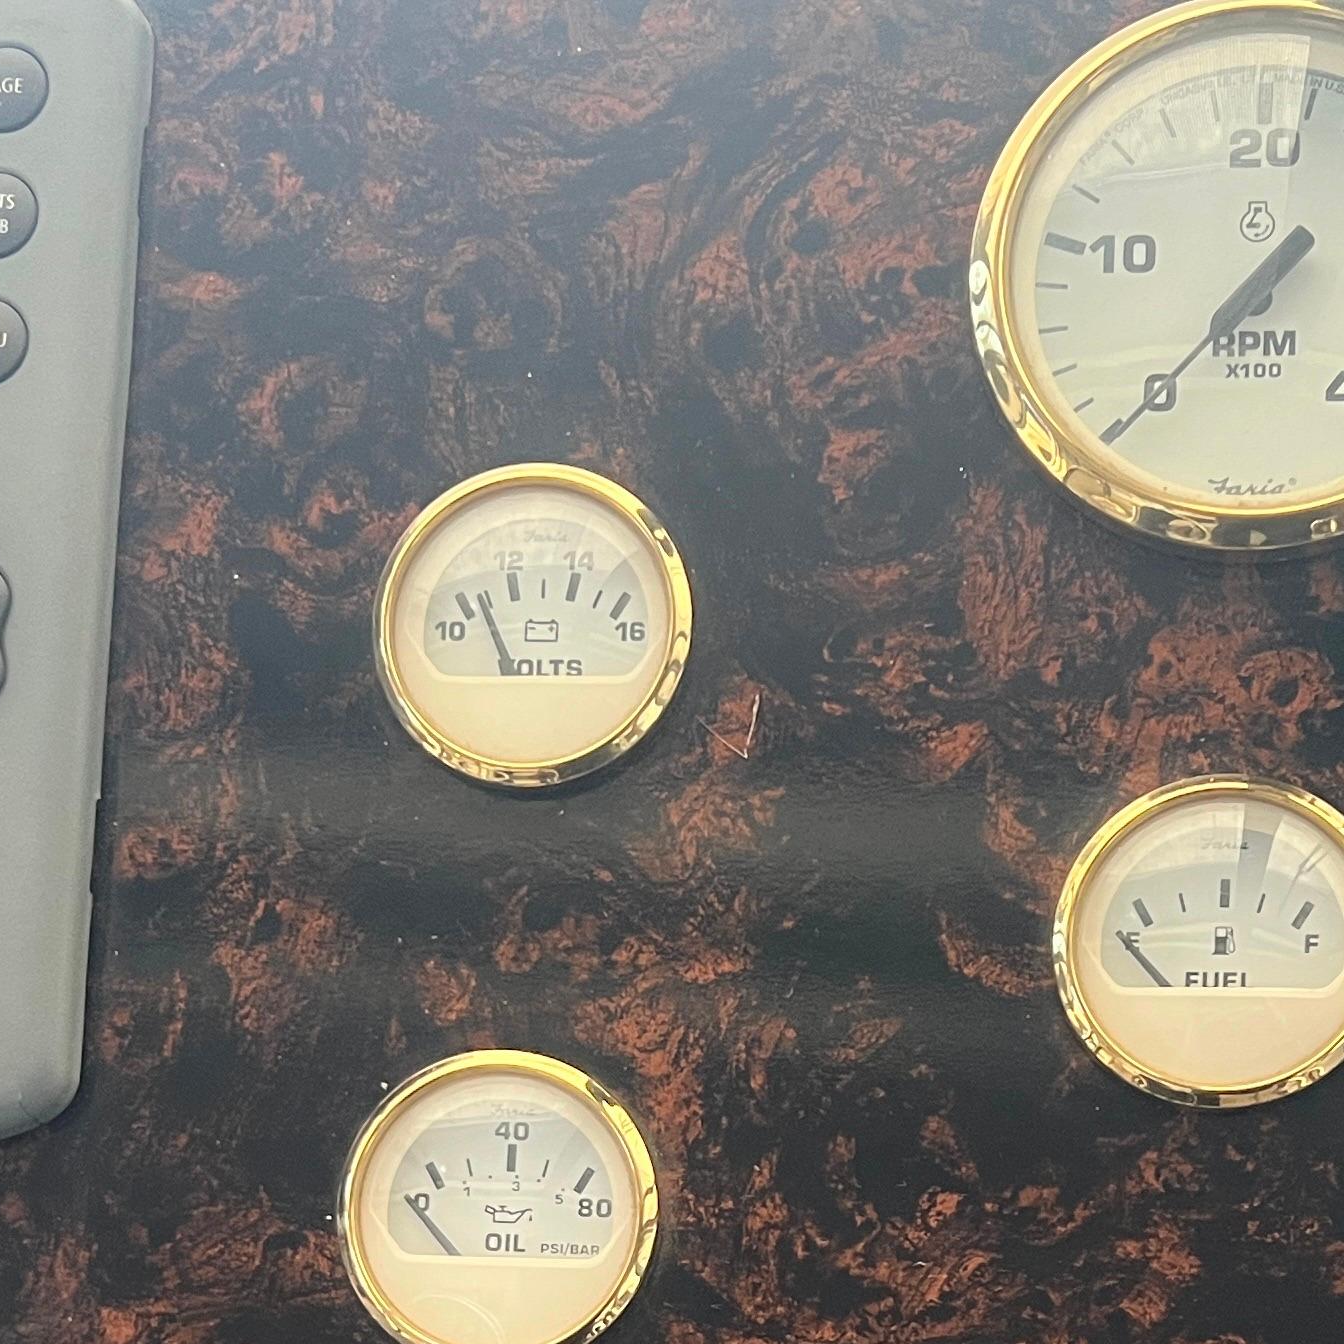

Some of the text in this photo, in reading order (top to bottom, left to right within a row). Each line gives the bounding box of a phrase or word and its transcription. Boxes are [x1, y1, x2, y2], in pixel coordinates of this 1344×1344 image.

[1229, 127, 1300, 169] 20
[1089, 234, 1157, 274] 10
[1212, 330, 1296, 357] RPM
[1225, 363, 1282, 379] X100
[1143, 373, 1177, 412] 0
[494, 551, 524, 570] 12
[563, 551, 594, 570] 14
[435, 621, 465, 641] 10
[614, 622, 645, 641] 16
[1305, 934, 1319, 953] F
[495, 1122, 529, 1140] 40
[464, 1186, 470, 1197] 1
[512, 1181, 520, 1192] 3
[413, 1193, 429, 1211] 0
[555, 1194, 563, 1204] 5
[578, 1198, 612, 1218] 80
[485, 1233, 600, 1256] OIL PSI/BAR
